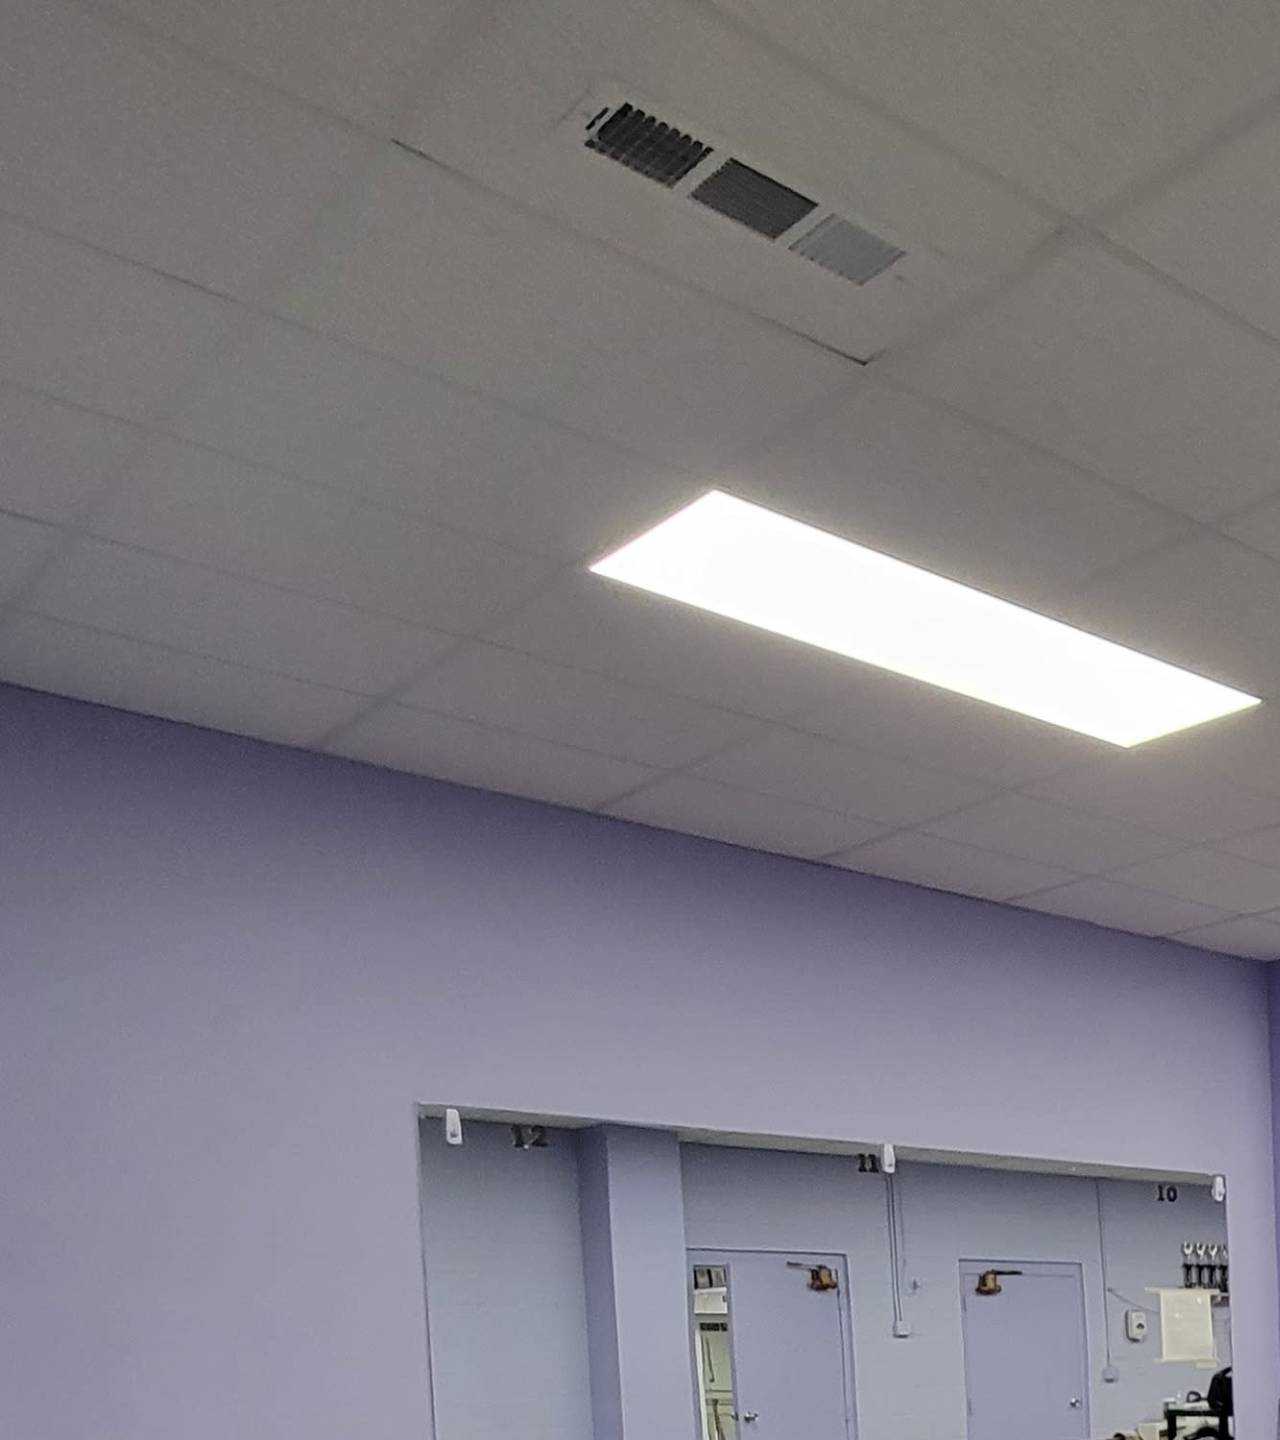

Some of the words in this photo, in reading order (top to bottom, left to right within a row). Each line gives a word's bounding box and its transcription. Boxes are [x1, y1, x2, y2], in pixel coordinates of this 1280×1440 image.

[510, 1124, 549, 1148] 12
[857, 1153, 879, 1173] 11
[1157, 1185, 1178, 1202] 10
